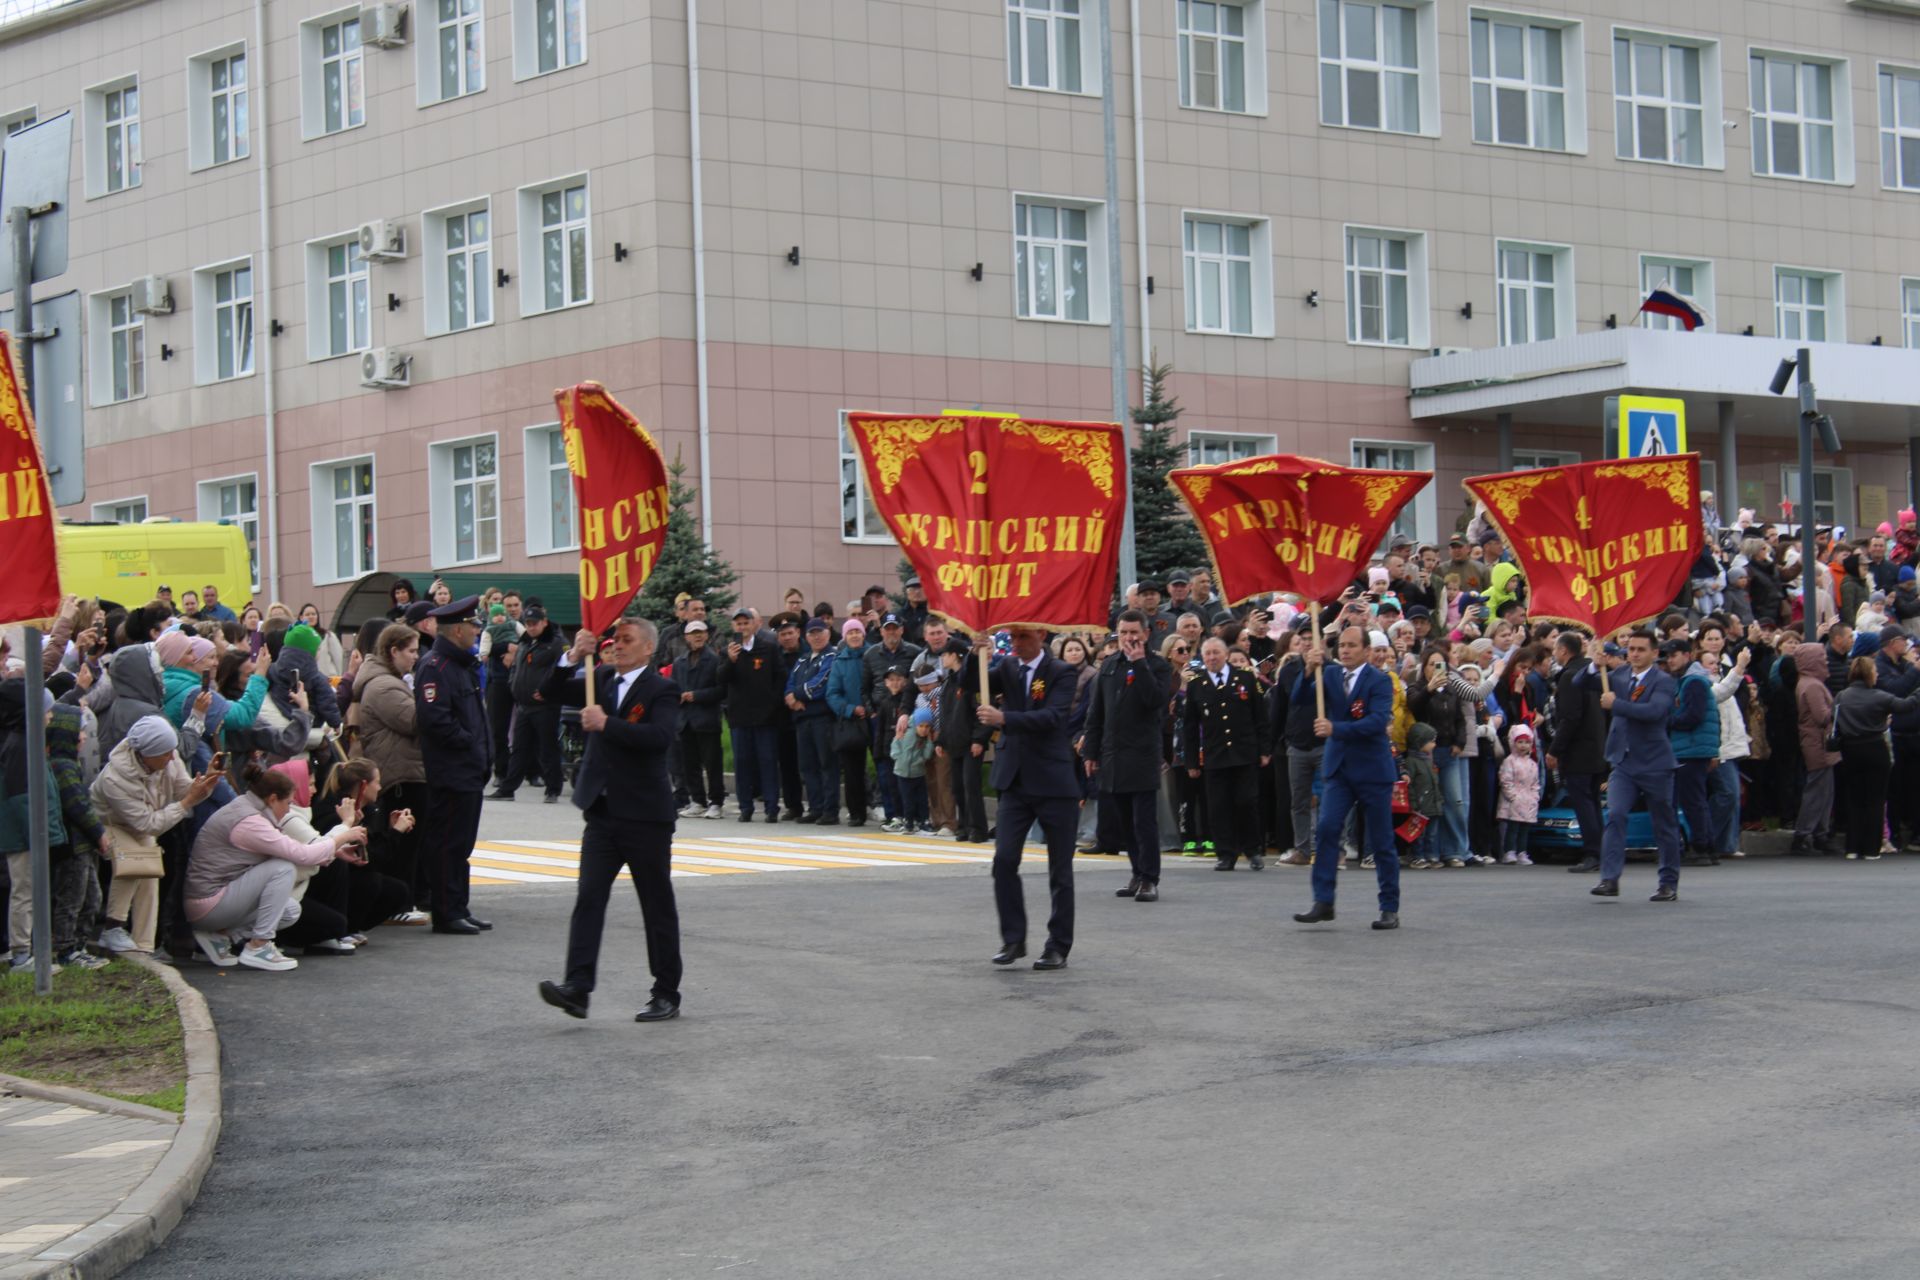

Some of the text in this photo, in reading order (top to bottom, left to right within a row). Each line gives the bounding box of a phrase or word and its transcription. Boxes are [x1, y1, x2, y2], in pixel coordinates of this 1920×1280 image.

[968, 450, 988, 494] 2
[1575, 496, 1592, 529] 4
[1526, 519, 1688, 578] УКРНСКИЙ
